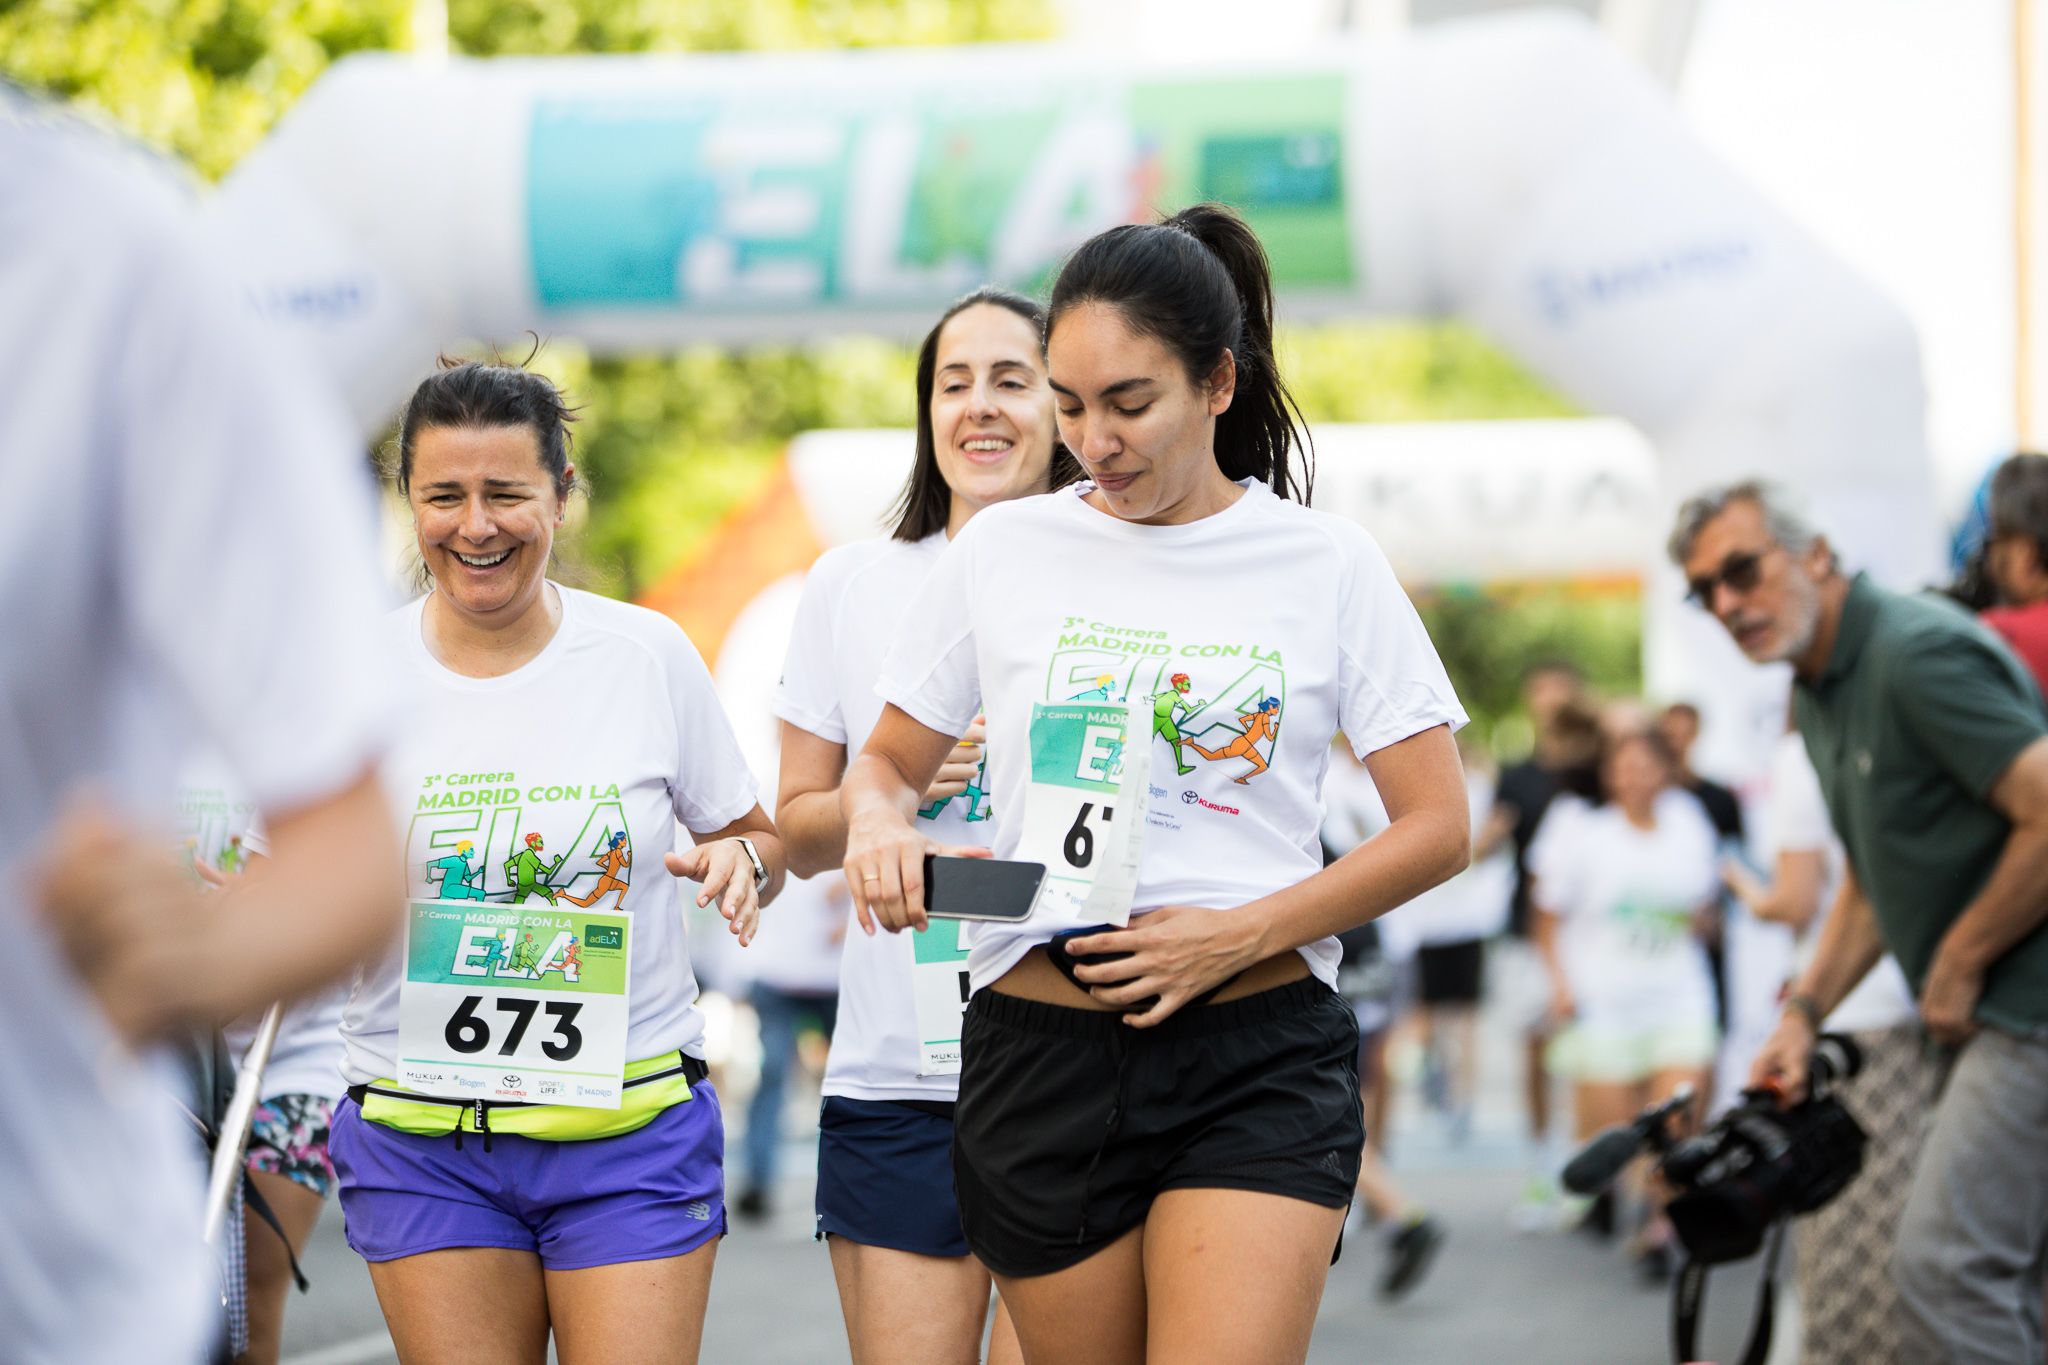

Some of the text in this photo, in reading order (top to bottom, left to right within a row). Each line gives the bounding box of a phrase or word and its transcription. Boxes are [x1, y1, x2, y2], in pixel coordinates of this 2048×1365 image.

[1090, 622, 1168, 640] Carrera
[1057, 632, 1283, 667] MADRID CON LA
[1047, 711, 1083, 721] Carrera
[1087, 712, 1128, 726] MADR
[1074, 724, 1125, 785] E
[446, 772, 515, 786] Carrera
[417, 783, 620, 811] MADRID CON LA
[404, 801, 632, 904] ELA
[429, 911, 461, 921] Carrera
[464, 913, 520, 927] MADRID
[523, 916, 553, 929] CON
[555, 918, 574, 930] LA
[451, 925, 579, 983] ELA
[445, 995, 583, 1062] 673
[931, 1053, 960, 1061] MUKU
[406, 1071, 486, 1089] MUKUA Biogen
[540, 1087, 558, 1095] LIFE
